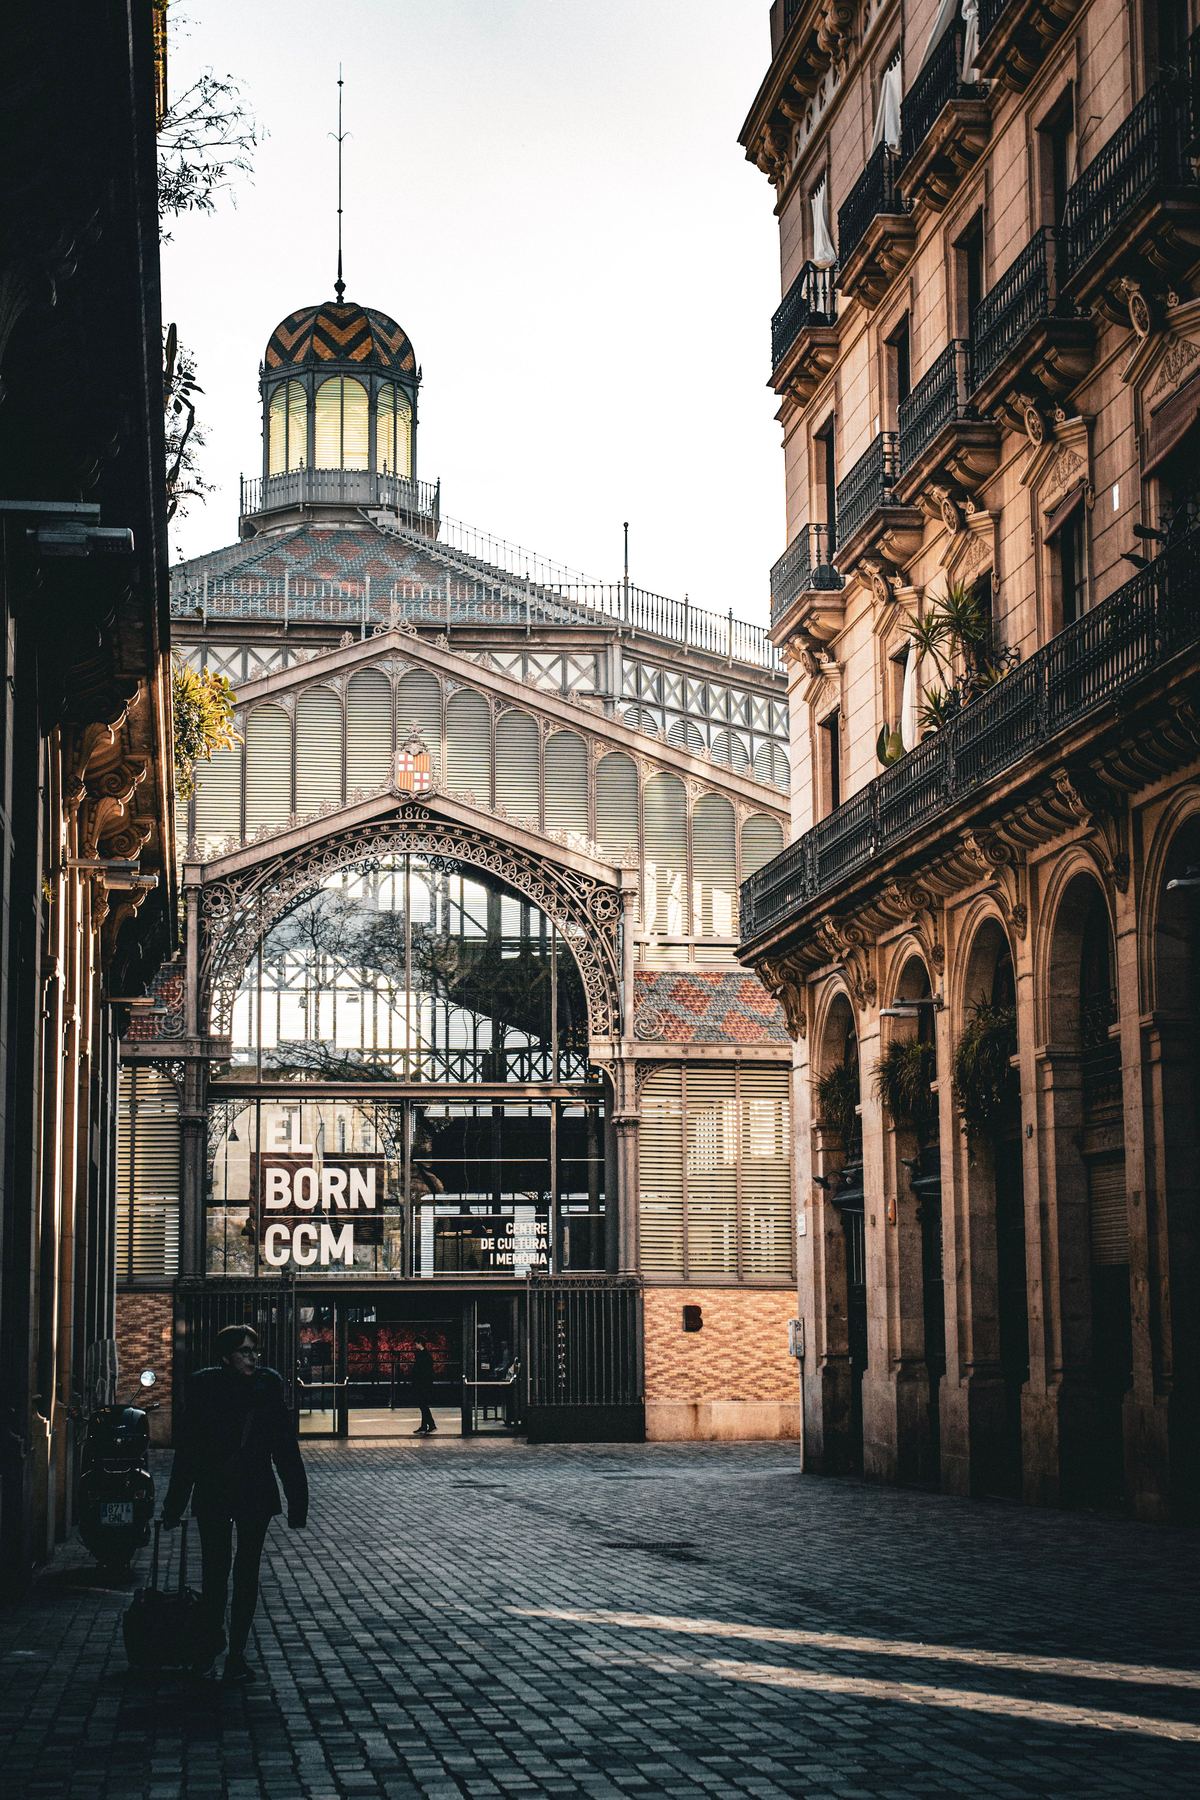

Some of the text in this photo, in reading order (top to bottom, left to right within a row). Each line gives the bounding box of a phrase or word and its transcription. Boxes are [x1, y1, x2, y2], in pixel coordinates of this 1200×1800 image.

[266, 1112, 313, 1153] EL
[265, 1167, 376, 1209] BORN
[505, 1222, 548, 1235] CENTRE
[265, 1223, 354, 1266] CCM
[480, 1237, 548, 1250] DE CULTURA
[490, 1253, 494, 1265] I
